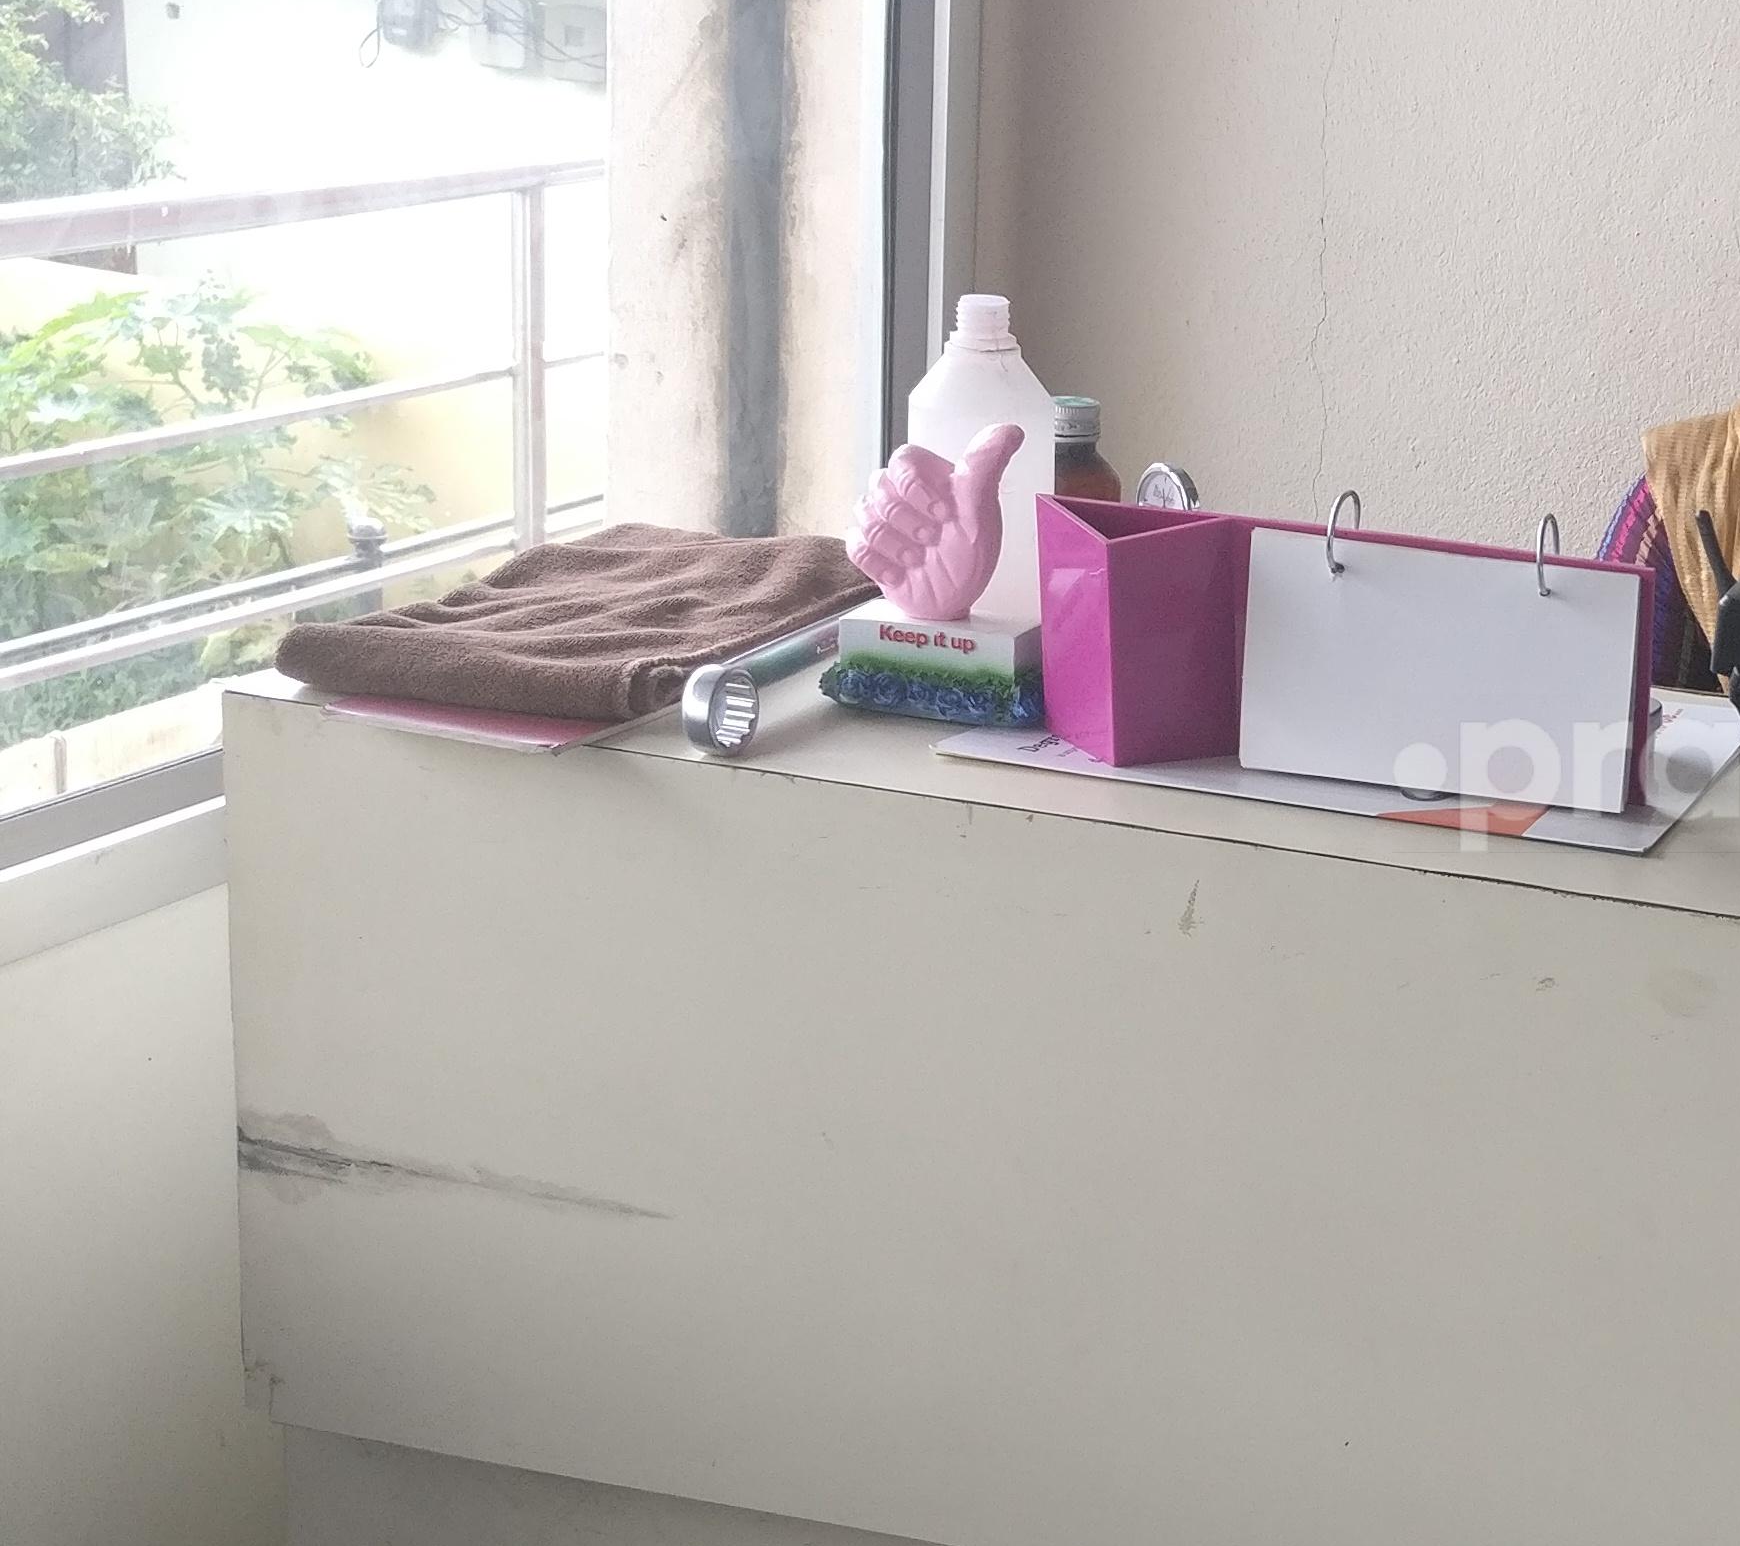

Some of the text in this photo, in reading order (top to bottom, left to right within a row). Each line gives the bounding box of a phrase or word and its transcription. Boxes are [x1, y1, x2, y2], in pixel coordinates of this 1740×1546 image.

[879, 624, 977, 654] Keep it up
